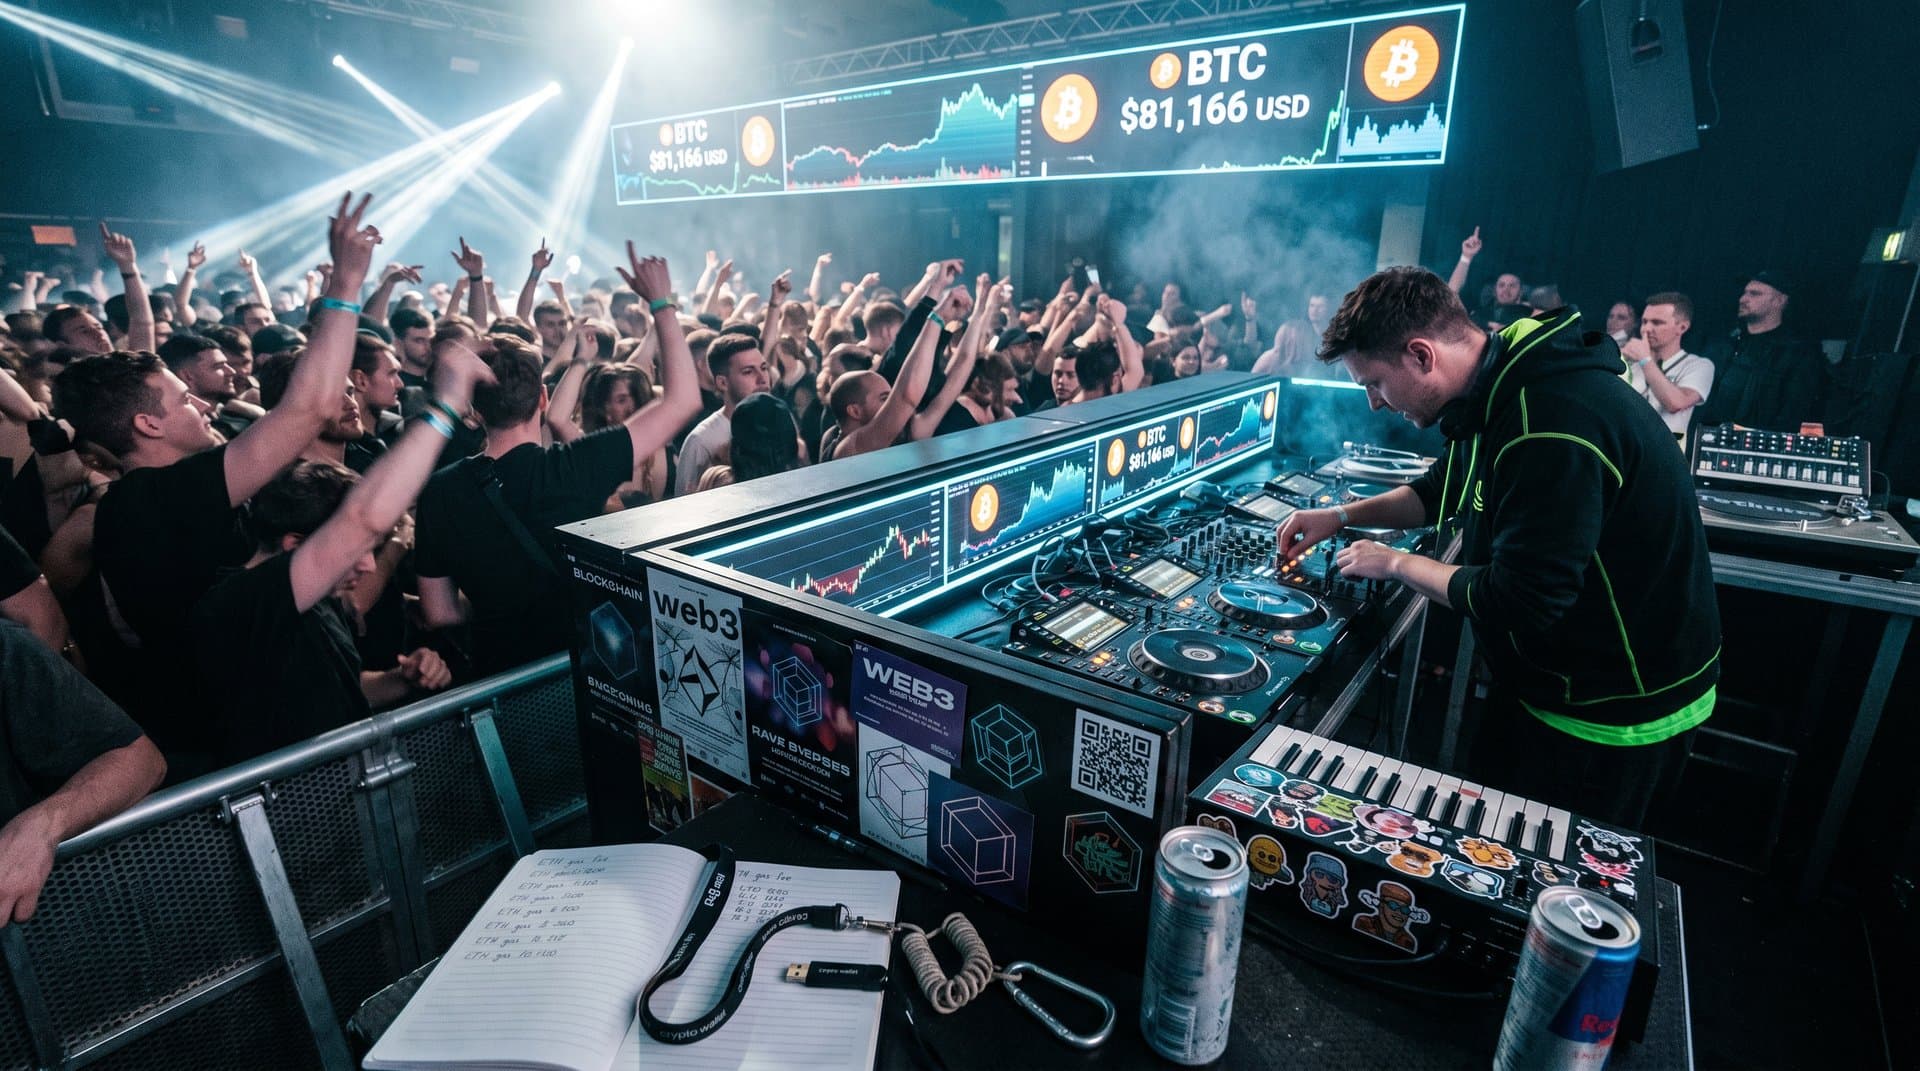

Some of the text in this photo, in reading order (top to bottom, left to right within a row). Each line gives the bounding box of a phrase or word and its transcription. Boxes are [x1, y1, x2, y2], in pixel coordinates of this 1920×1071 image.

[1187, 43, 1267, 86] BTC
[1120, 90, 1310, 135] $81,166 USD
[674, 118, 708, 145] BTC
[649, 147, 728, 173] $81,166 USD
[1147, 424, 1167, 446] BTC
[1128, 445, 1175, 472] $81,166 USD
[653, 590, 739, 641] web3
[863, 657, 954, 711] WEB3
[752, 725, 785, 748] RAVE
